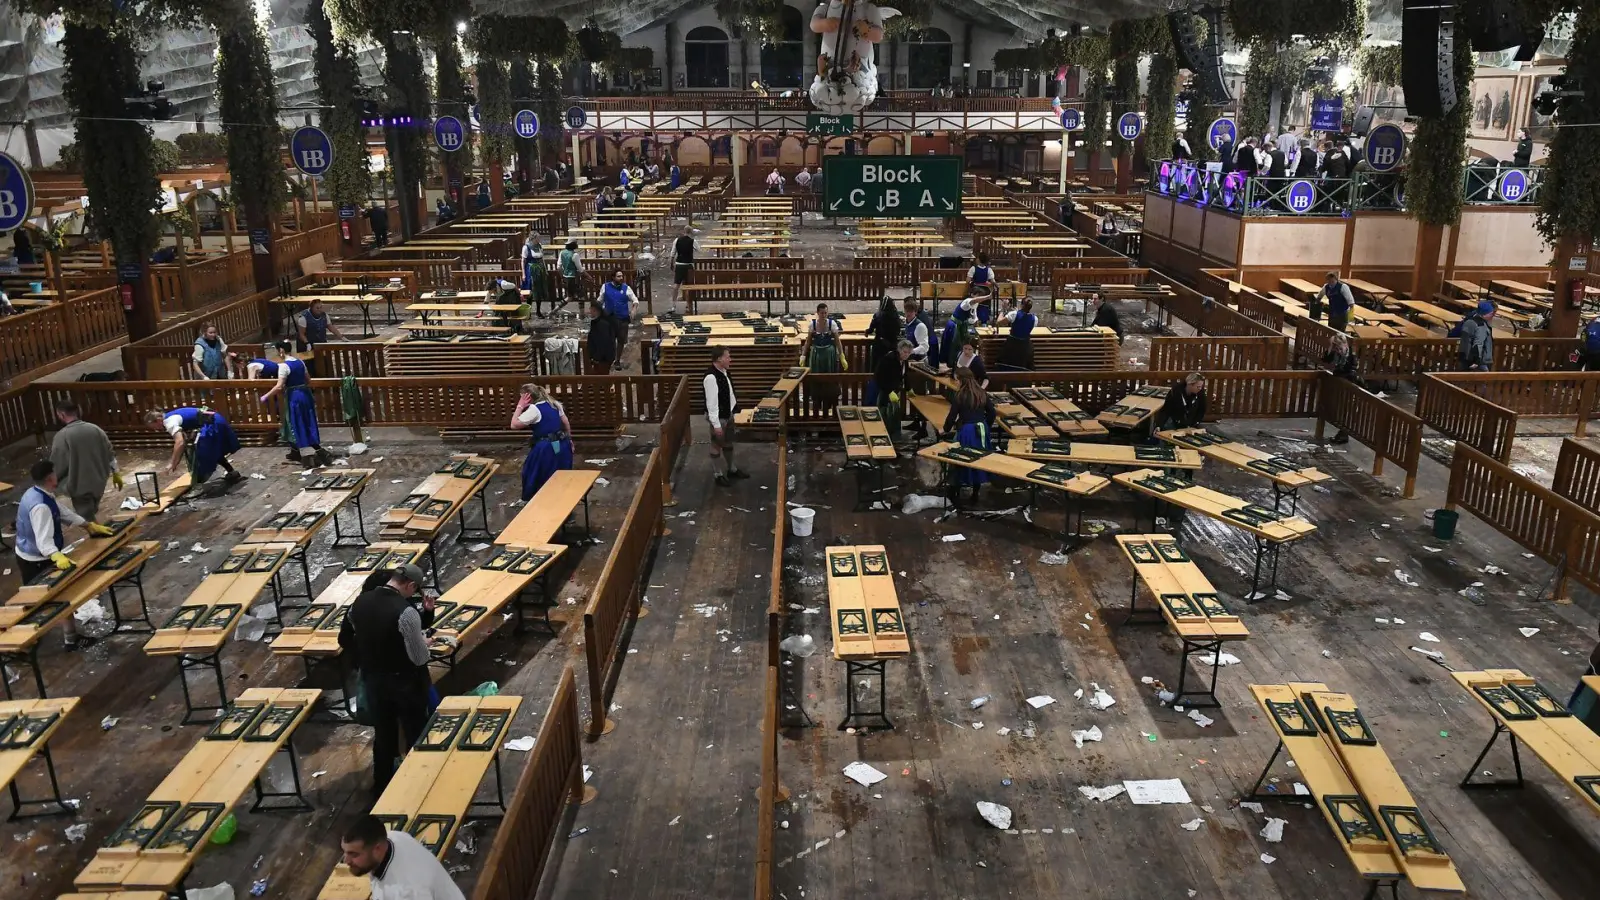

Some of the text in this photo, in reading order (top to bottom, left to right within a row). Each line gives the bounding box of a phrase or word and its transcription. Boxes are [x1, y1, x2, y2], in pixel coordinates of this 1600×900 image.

[570, 117, 582, 126] HB
[1065, 118, 1076, 128] HB
[520, 123, 534, 134] HB
[1123, 125, 1137, 136] HB
[441, 132, 459, 146] HB
[301, 150, 326, 168] HB
[1373, 147, 1395, 165] HB
[862, 164, 923, 183] Block
[1505, 184, 1521, 197] HB
[0, 190, 18, 218] B
[849, 188, 935, 207] C B A
[1292, 195, 1308, 208] HB
